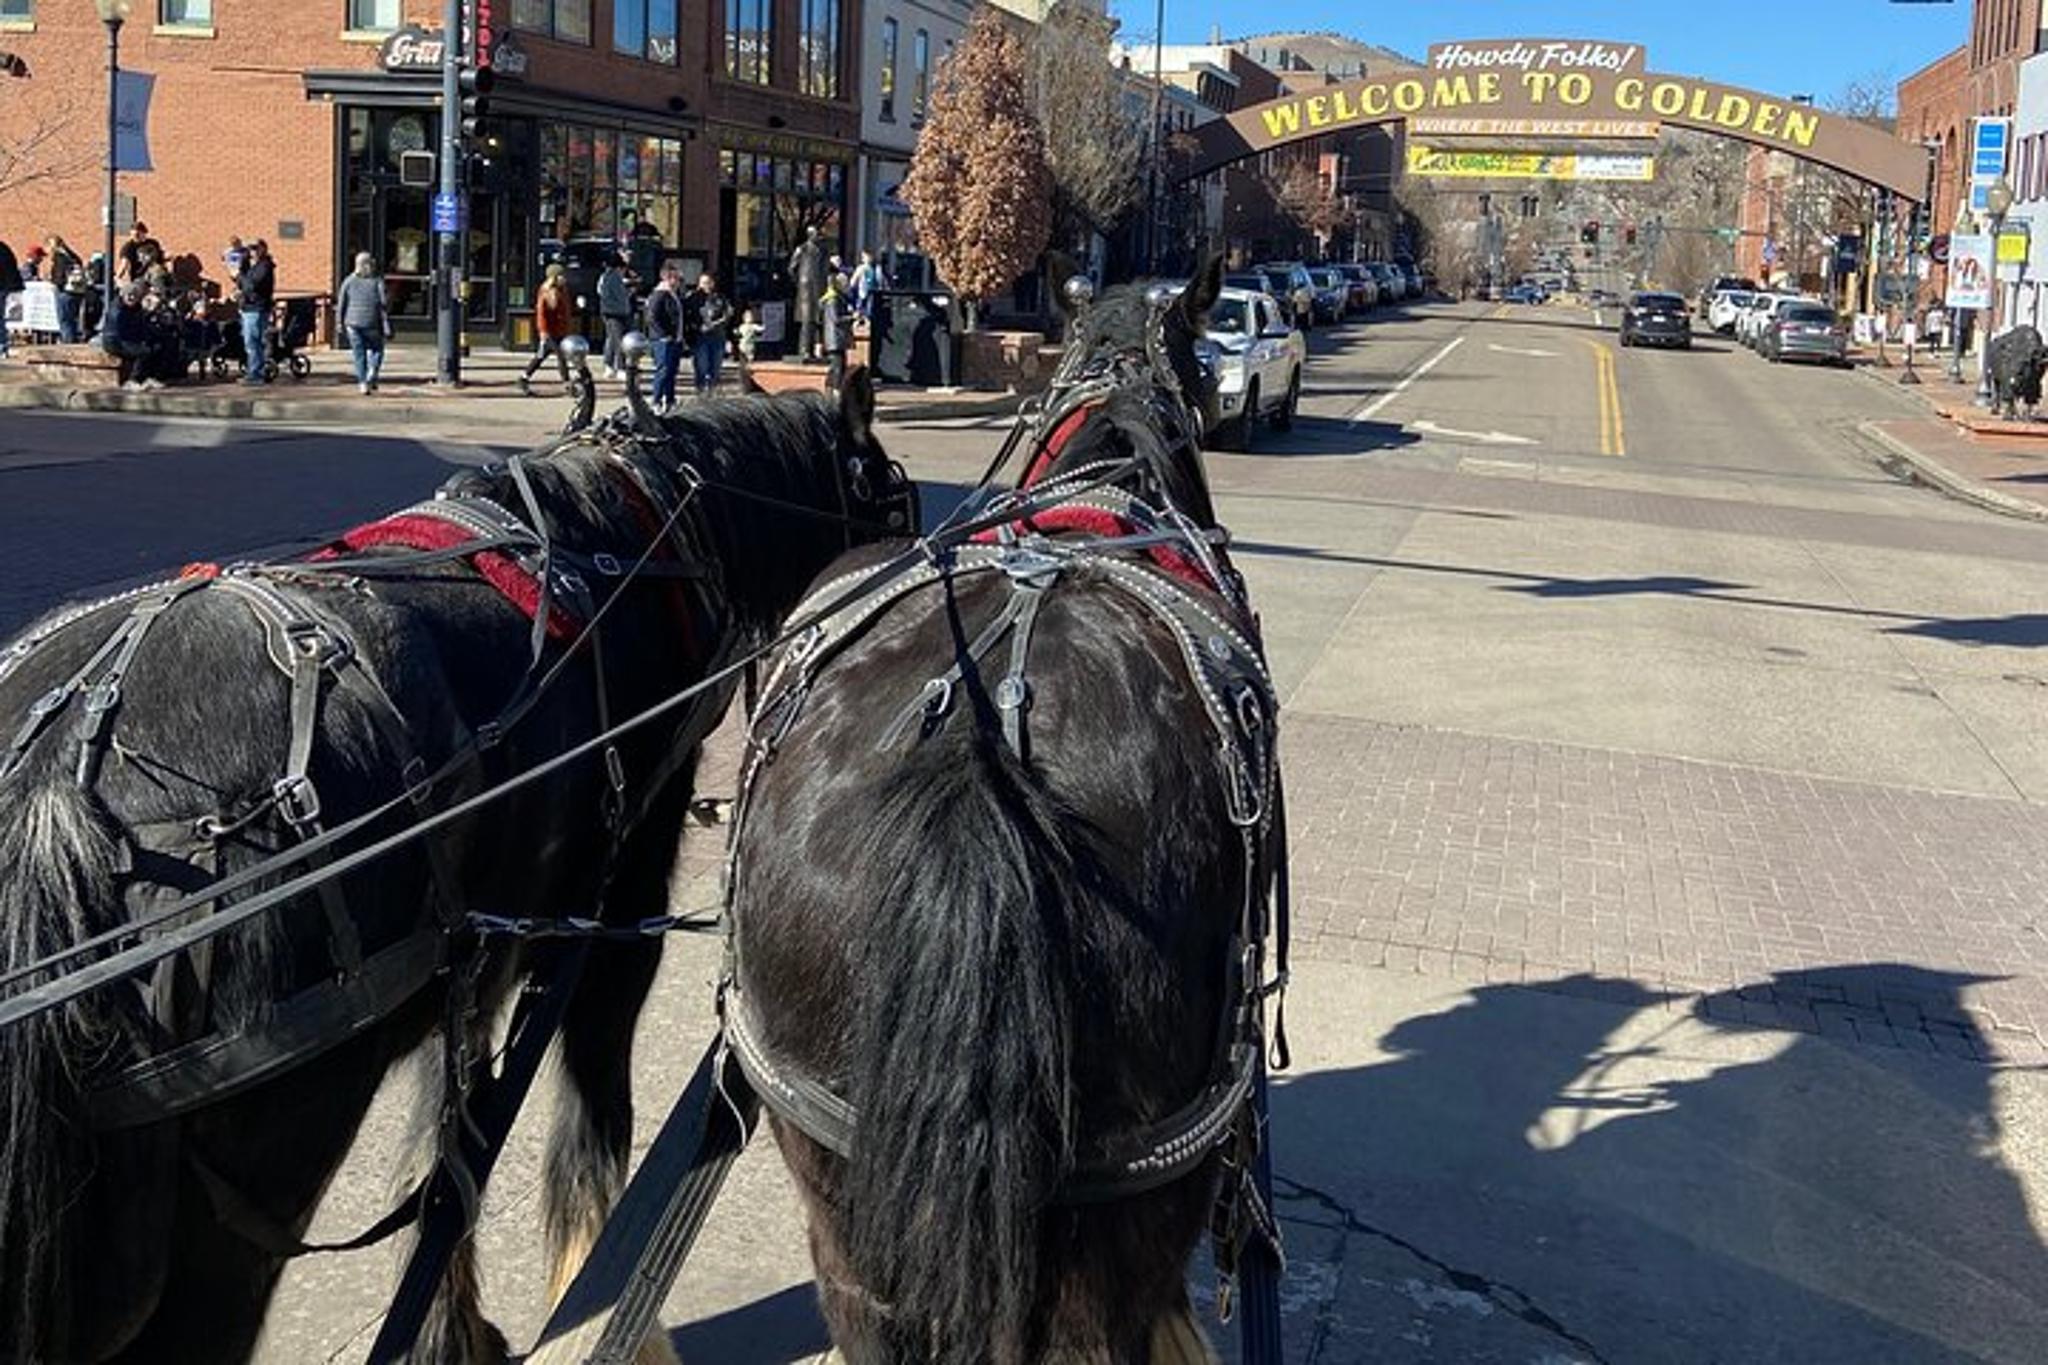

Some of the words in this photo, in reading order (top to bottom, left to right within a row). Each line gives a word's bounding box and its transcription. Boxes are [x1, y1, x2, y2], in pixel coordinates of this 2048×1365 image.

[1434, 42, 1537, 70] Howdy
[1538, 42, 1637, 73] Folks!
[1261, 73, 1502, 138] WELCOME
[1522, 72, 1593, 104] TO
[1614, 78, 1820, 147] GOLDEN
[1415, 119, 1479, 134] WHERE
[1492, 120, 1524, 134] THE
[1533, 120, 1586, 135] WEST
[1592, 120, 1650, 136] LIVES
